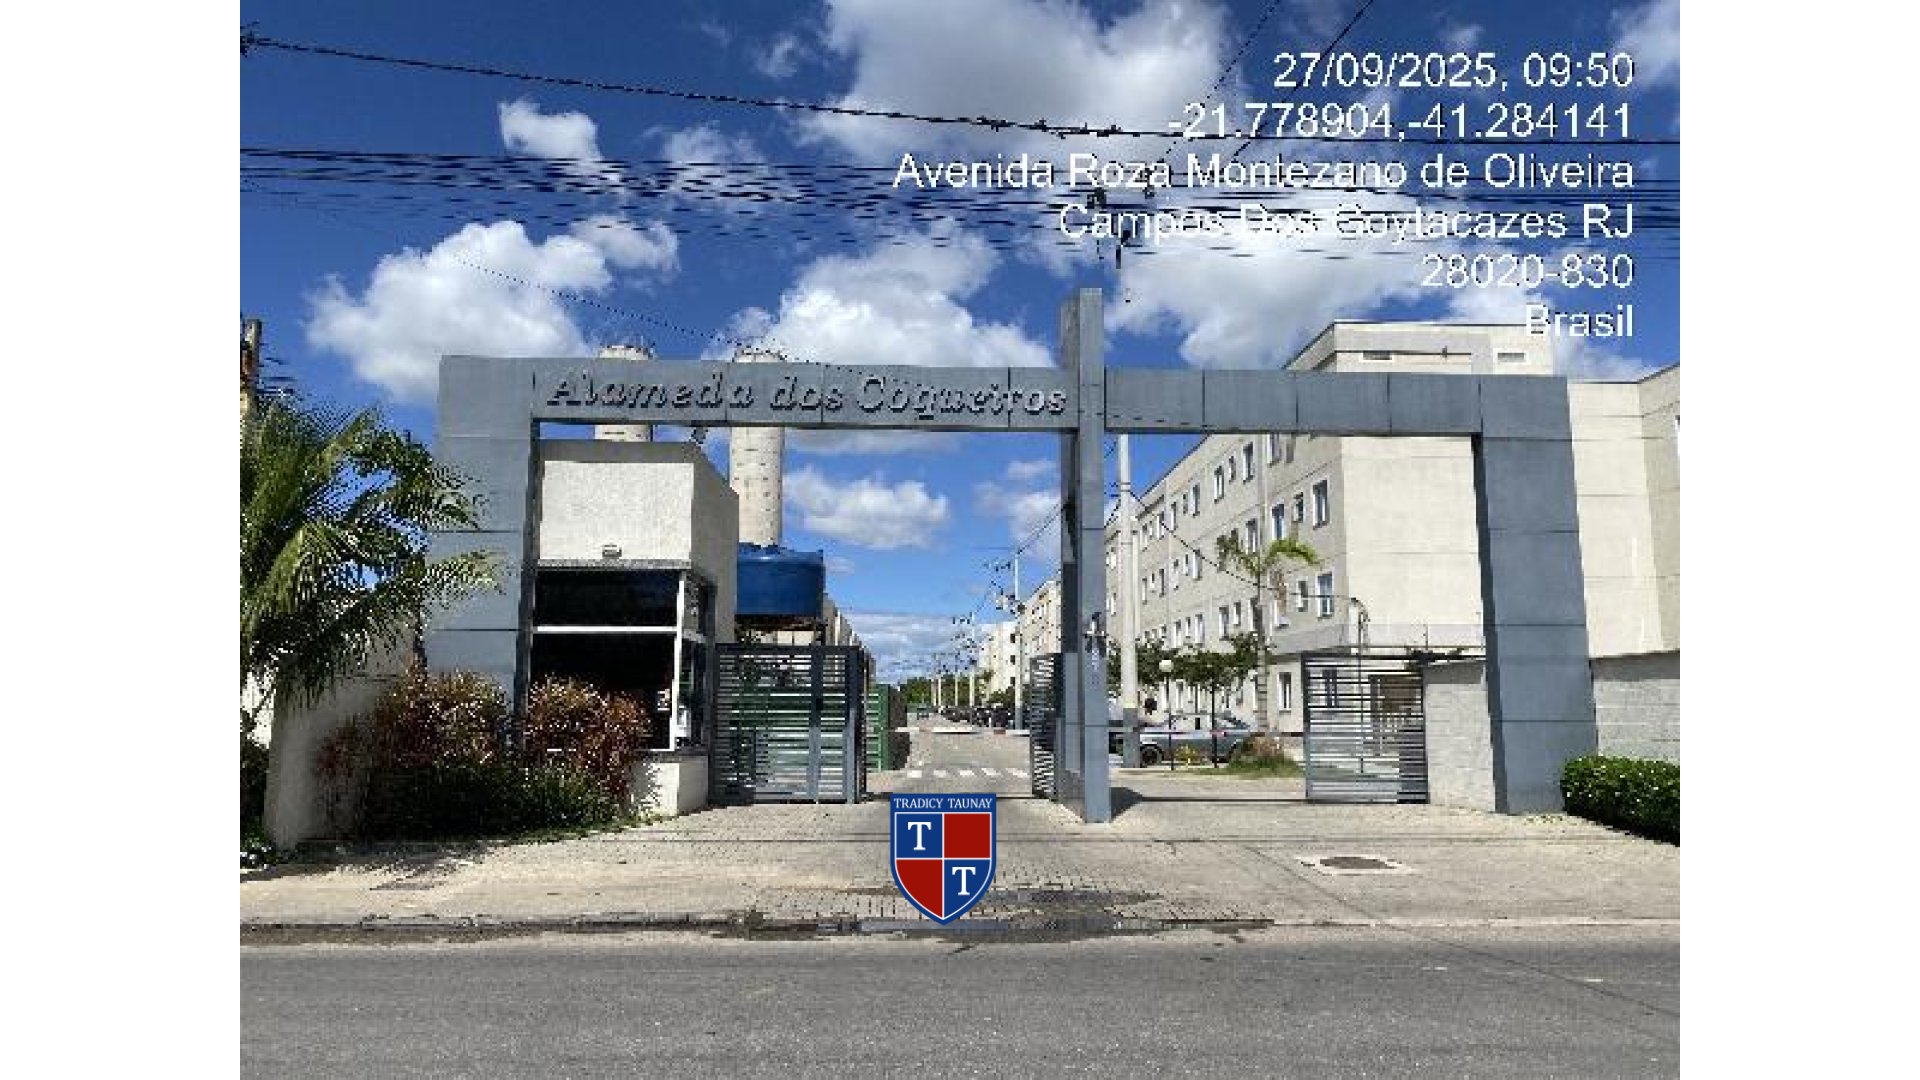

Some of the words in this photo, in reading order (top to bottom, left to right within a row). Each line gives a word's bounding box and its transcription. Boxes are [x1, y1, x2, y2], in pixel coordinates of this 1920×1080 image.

[546, 370, 755, 409] Alameda
[769, 376, 844, 411] dos
[857, 376, 1067, 421] Coqueiros
